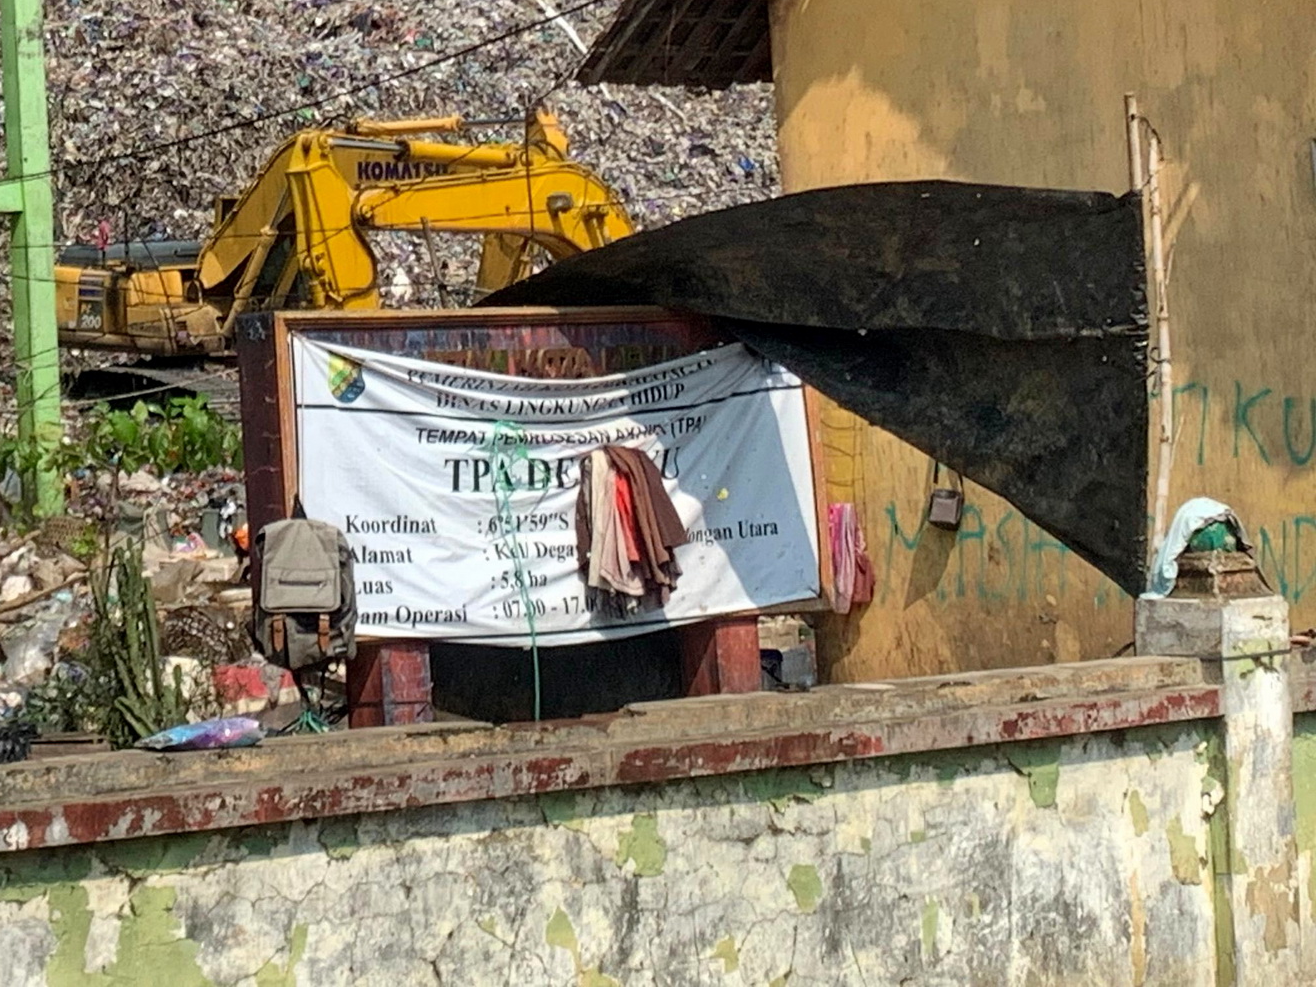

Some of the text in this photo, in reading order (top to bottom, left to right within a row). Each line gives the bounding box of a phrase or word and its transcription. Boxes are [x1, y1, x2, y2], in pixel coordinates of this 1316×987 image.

[357, 160, 449, 182] KOMATSU
[80, 314, 102, 330] 200
[436, 391, 501, 412] DINAS
[630, 382, 685, 406] HIDUP
[416, 427, 486, 445] TEMPAT
[444, 458, 516, 493] TPA
[345, 514, 437, 534] Koordinat
[533, 540, 575, 563] Dega
[737, 520, 779, 539] Utara
[355, 579, 394, 595] uas
[499, 570, 525, 590] 5,8
[528, 569, 548, 588] ha
[358, 610, 389, 625] am
[395, 603, 467, 628] Operasi
